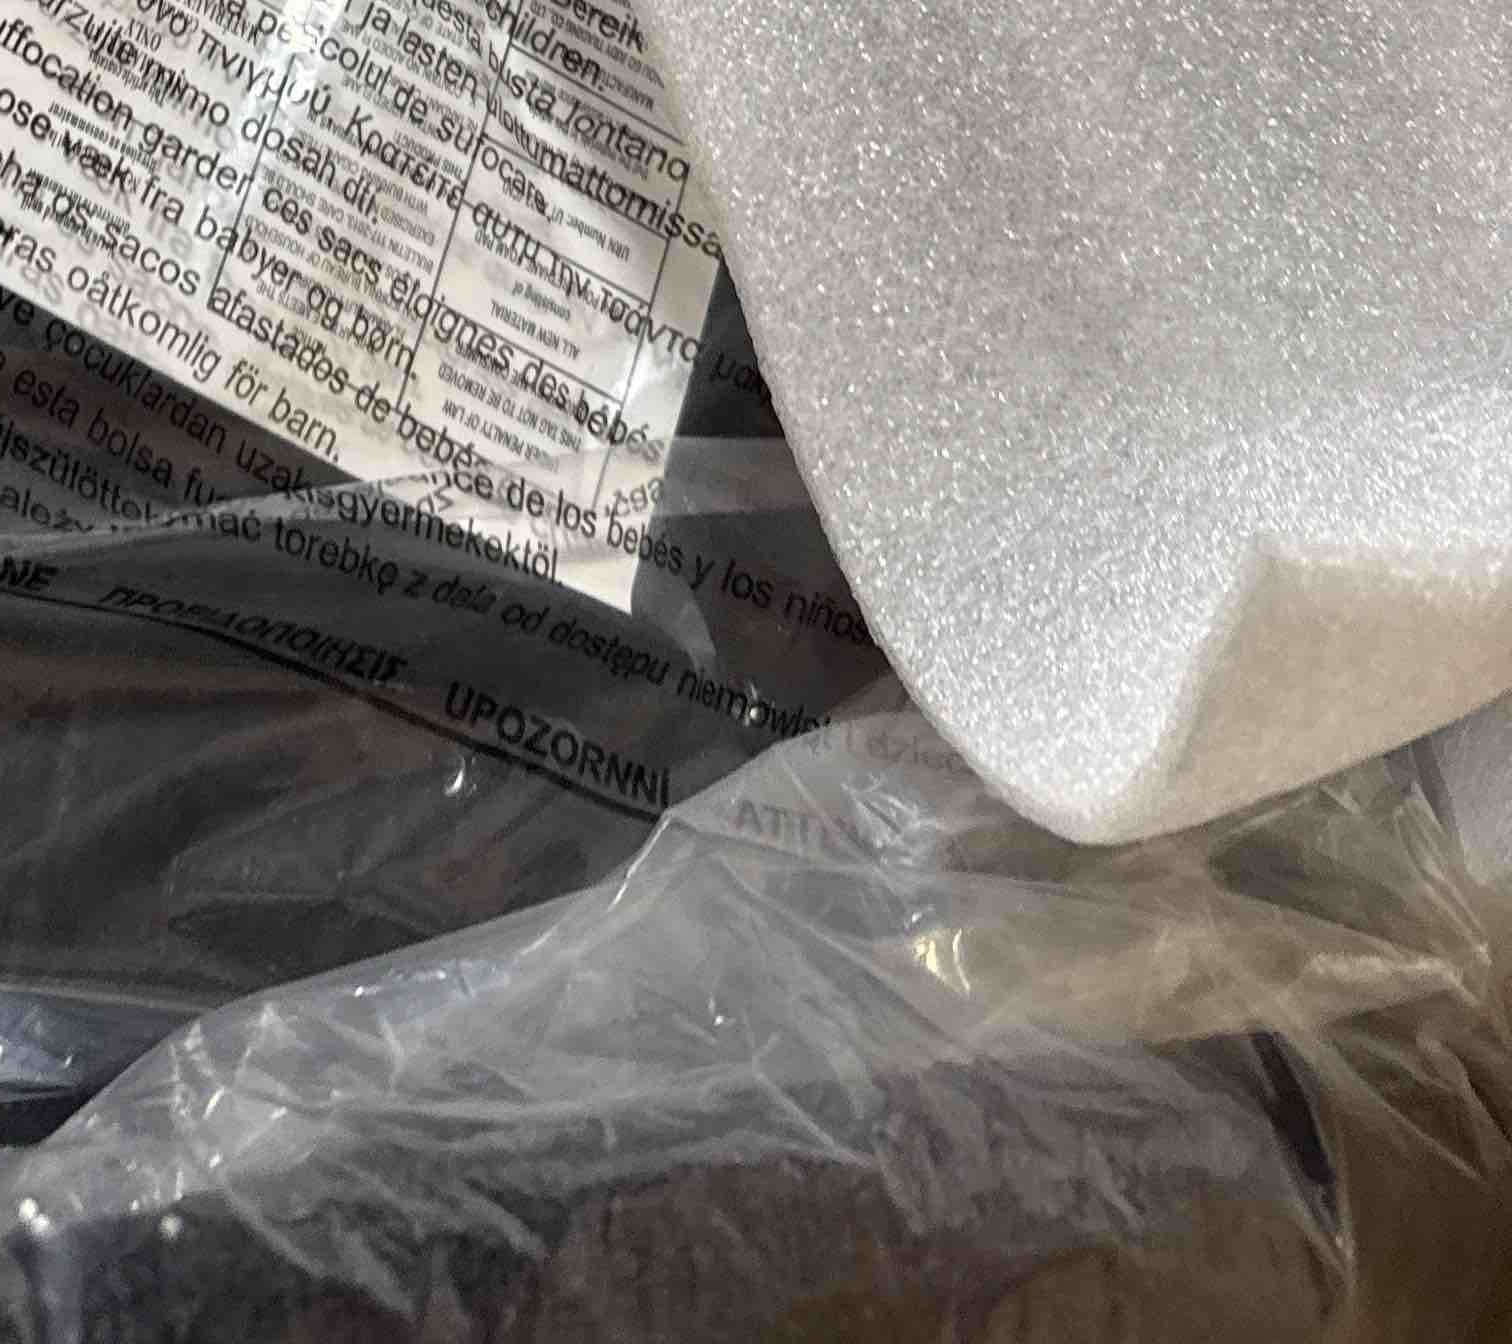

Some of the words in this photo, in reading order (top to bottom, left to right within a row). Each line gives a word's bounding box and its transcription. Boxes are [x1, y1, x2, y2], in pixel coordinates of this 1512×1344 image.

[137, 50, 235, 129] mimo
[235, 109, 343, 188] dosah
[390, 79, 434, 123] de
[393, 16, 486, 98] lasten
[561, 98, 695, 188] lontano
[46, 187, 96, 233] os
[95, 219, 204, 299] sacos
[206, 284, 354, 397] afastados
[350, 374, 399, 424] de
[62, 255, 229, 385] oåtkomlig
[134, 115, 256, 200] garder
[255, 184, 317, 236] ces
[312, 226, 387, 287] sacs
[516, 355, 577, 412] des
[135, 173, 192, 226] fra
[190, 205, 307, 301] babyer
[298, 281, 348, 330] og
[345, 304, 432, 382] børn.
[8, 361, 88, 429] esta
[82, 406, 184, 492] bolsa
[223, 356, 273, 409] för
[266, 385, 351, 464] barn.
[501, 475, 554, 519] de
[550, 493, 603, 543] los
[603, 509, 693, 572] bebés
